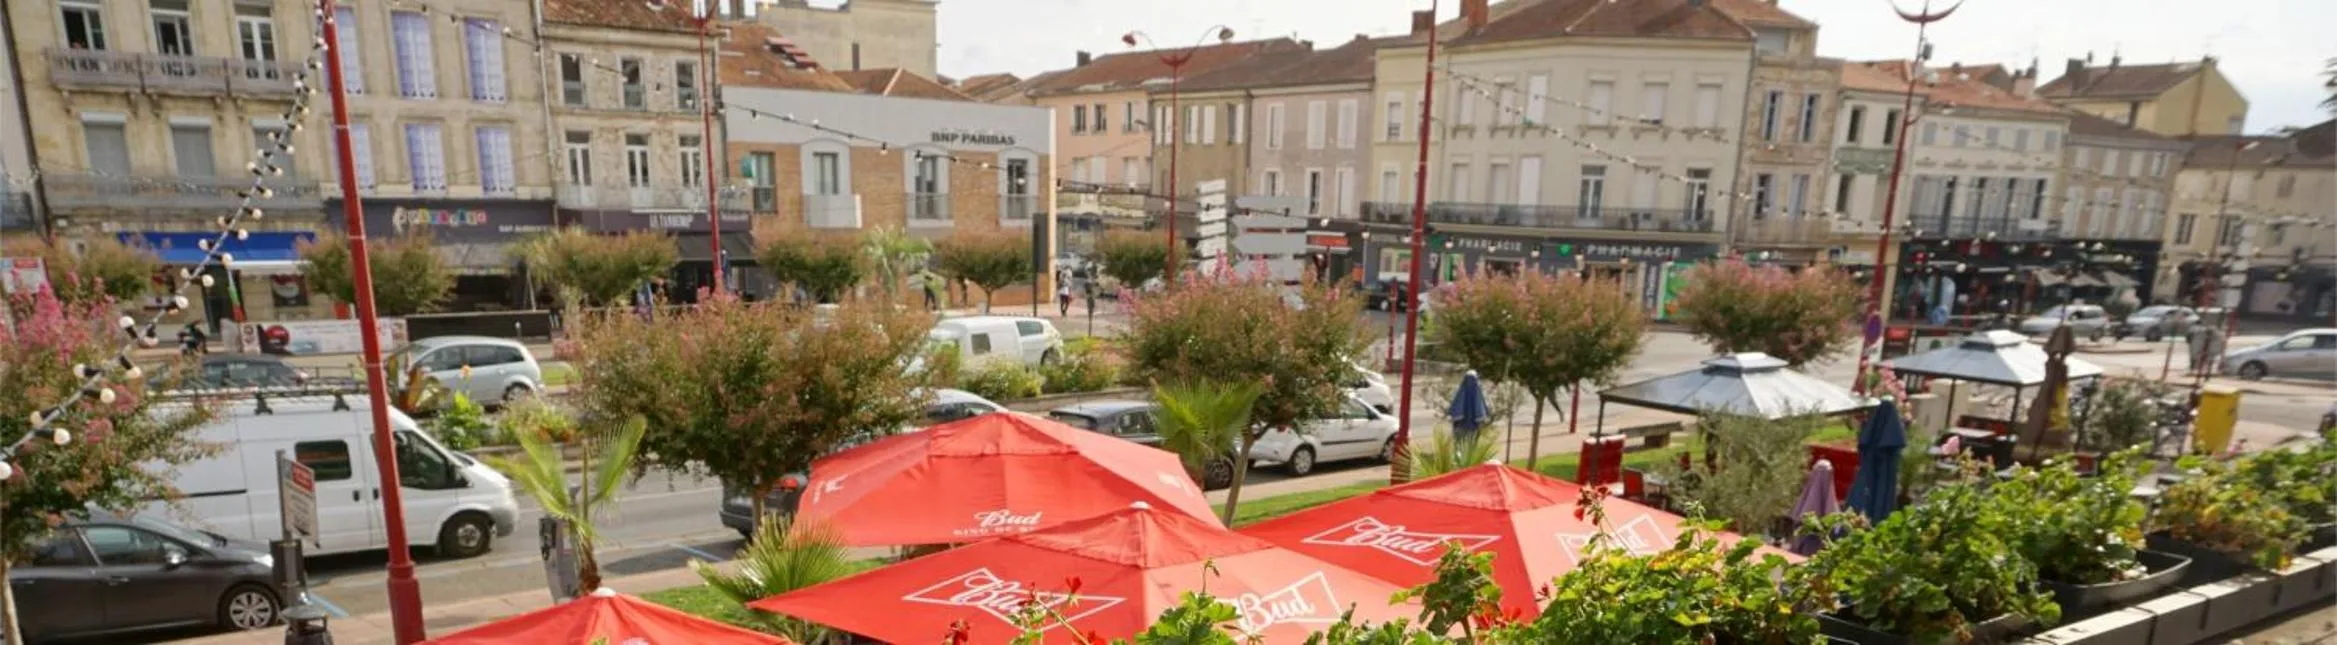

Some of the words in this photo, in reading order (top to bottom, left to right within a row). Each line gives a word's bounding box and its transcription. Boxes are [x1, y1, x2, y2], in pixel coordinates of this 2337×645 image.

[931, 131, 960, 142] BNP
[962, 133, 1016, 146] PARIBAS
[973, 509, 1043, 528] Bud
[1344, 522, 1448, 554] Bud
[1237, 587, 1317, 635] Bud
